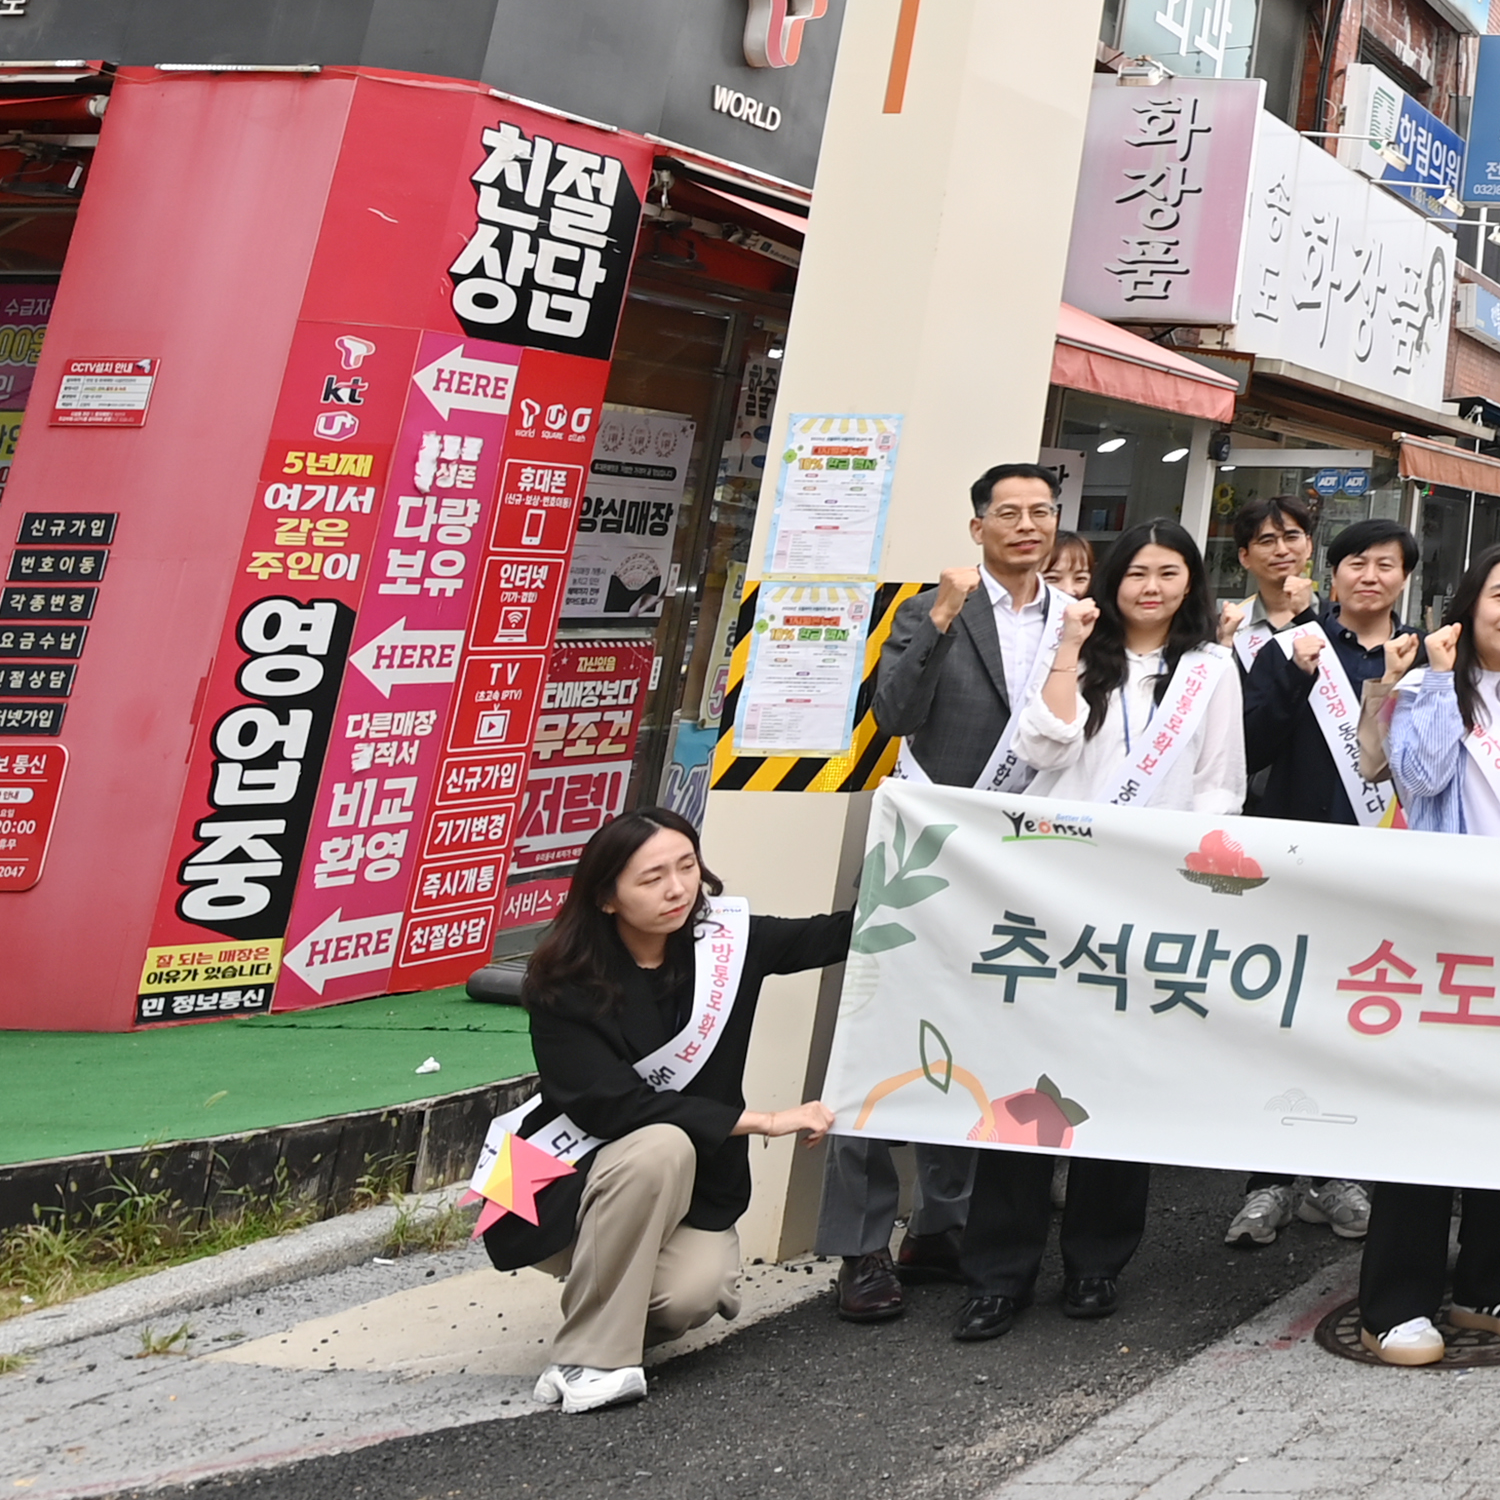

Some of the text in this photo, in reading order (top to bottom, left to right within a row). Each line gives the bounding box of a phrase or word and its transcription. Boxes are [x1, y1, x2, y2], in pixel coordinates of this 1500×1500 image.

[713, 84, 782, 132] WORLD
[470, 121, 624, 237] 친절
[1104, 97, 1212, 301] 화장품
[449, 221, 608, 339] 상담
[71, 362, 133, 373] CCTV설치 안내
[322, 376, 368, 405] kt
[432, 368, 508, 400] HERE
[283, 451, 373, 477] 5년째
[518, 467, 568, 493] 휴대폰
[264, 484, 375, 514] 여기서
[275, 518, 349, 547] 같은
[394, 496, 481, 545] 다량
[246, 552, 361, 581] 주인이
[378, 549, 466, 597] 보유
[500, 564, 549, 589] 인터넷
[373, 645, 455, 669] HERE
[345, 711, 437, 739] 다른매장
[181, 599, 337, 921] 영업중
[445, 762, 517, 793] 신규가입
[327, 776, 418, 828] 비교
[433, 814, 503, 846] 기기변경
[1008, 809, 1093, 841] Yeonsu
[315, 829, 409, 889] 환영
[423, 866, 495, 899] 즉시개통
[306, 928, 393, 967] HERE
[410, 918, 486, 954] 친절상담
[179, 947, 270, 966] 되는 매장은
[970, 910, 1310, 1029] 추석맞이
[147, 963, 272, 986] 이유가 있습니다
[171, 989, 265, 1014] 정보통신
